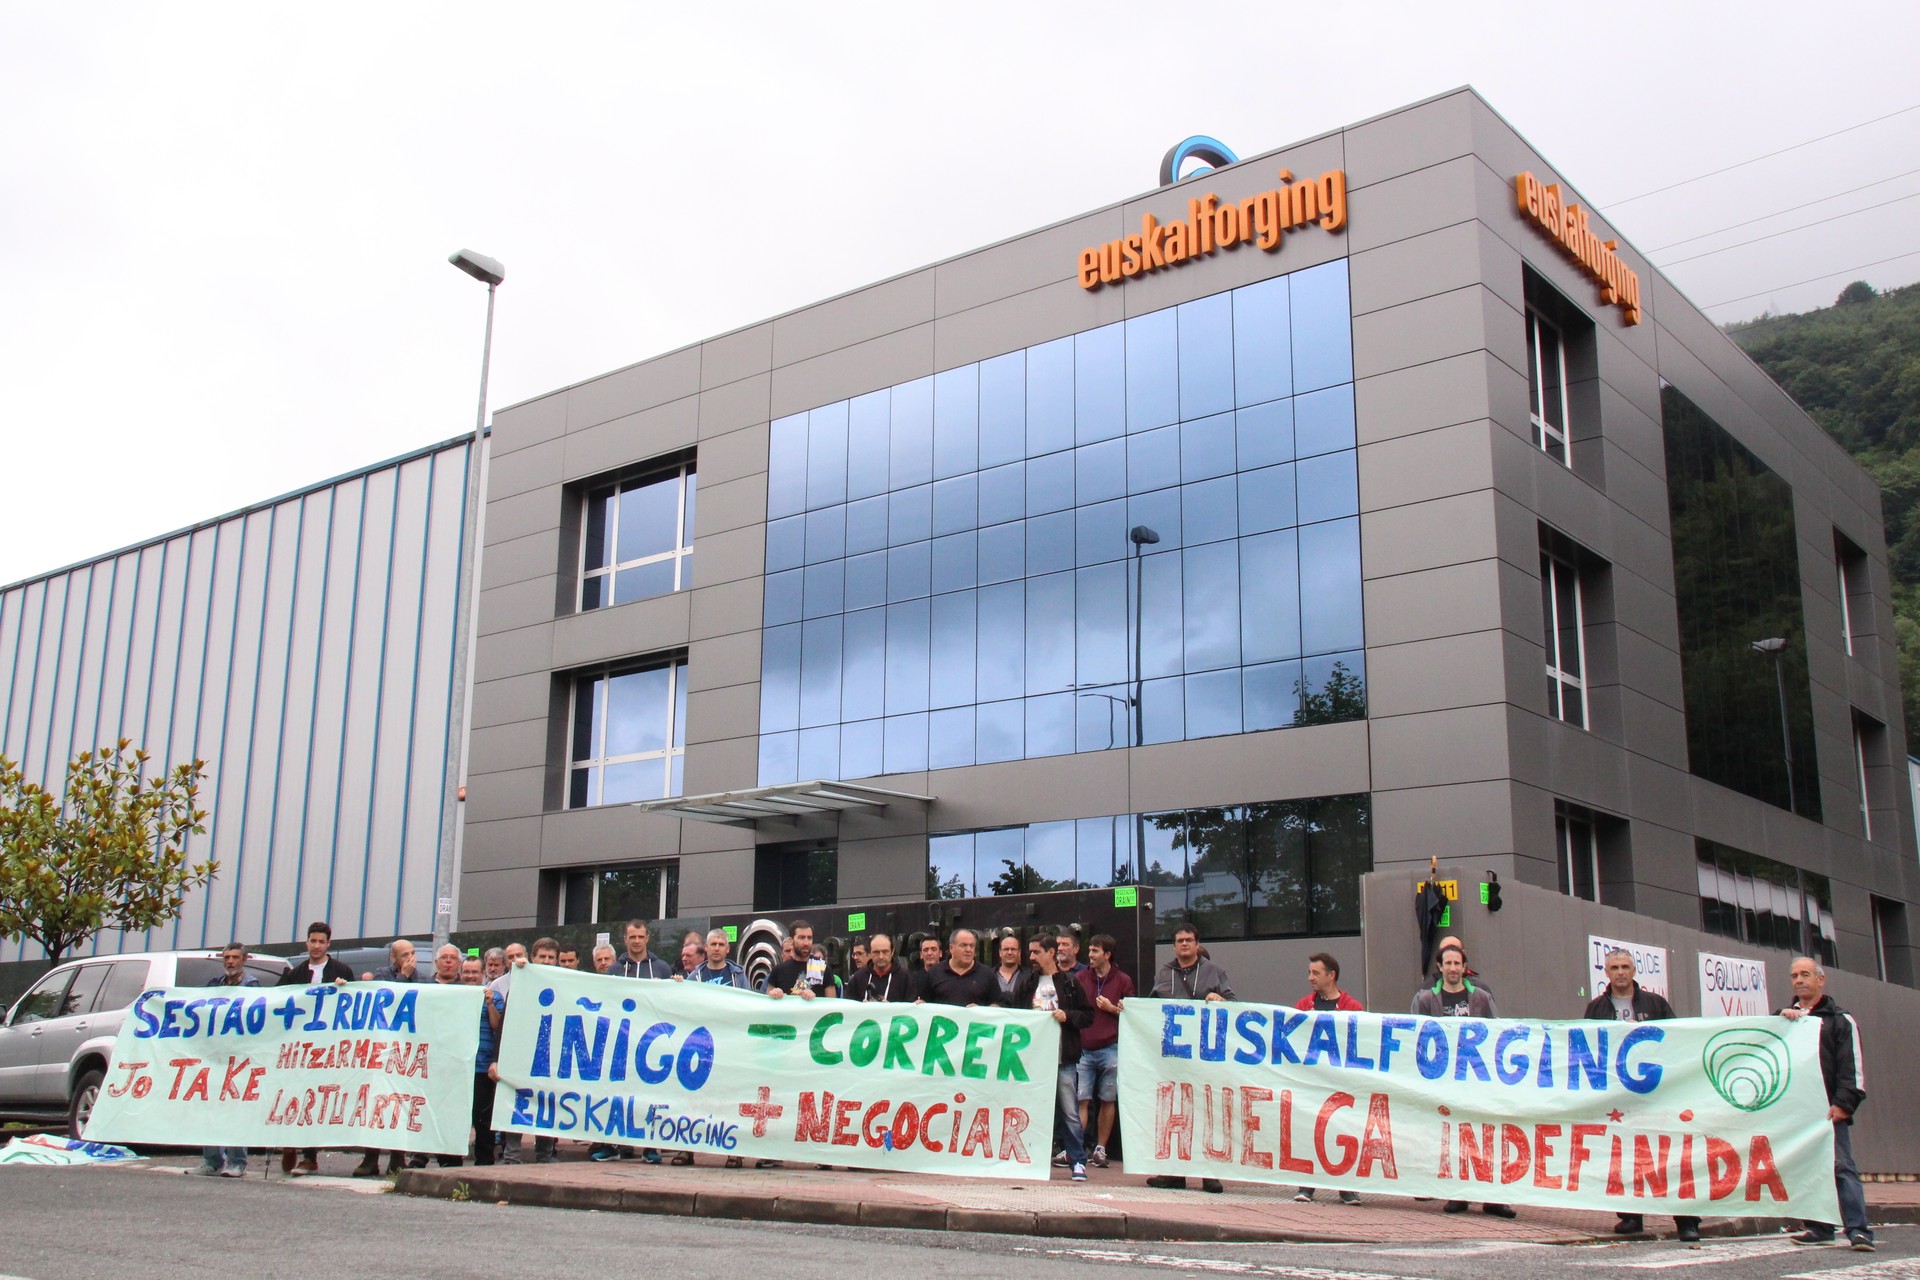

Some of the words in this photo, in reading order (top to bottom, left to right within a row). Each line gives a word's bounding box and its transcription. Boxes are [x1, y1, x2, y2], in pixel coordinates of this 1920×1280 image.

[1078, 168, 1346, 290] euskalforging
[1517, 171, 1641, 325] euskalforging
[809, 1011, 1031, 1082] CORRER
[1155, 1080, 1398, 1180] HUELGA
